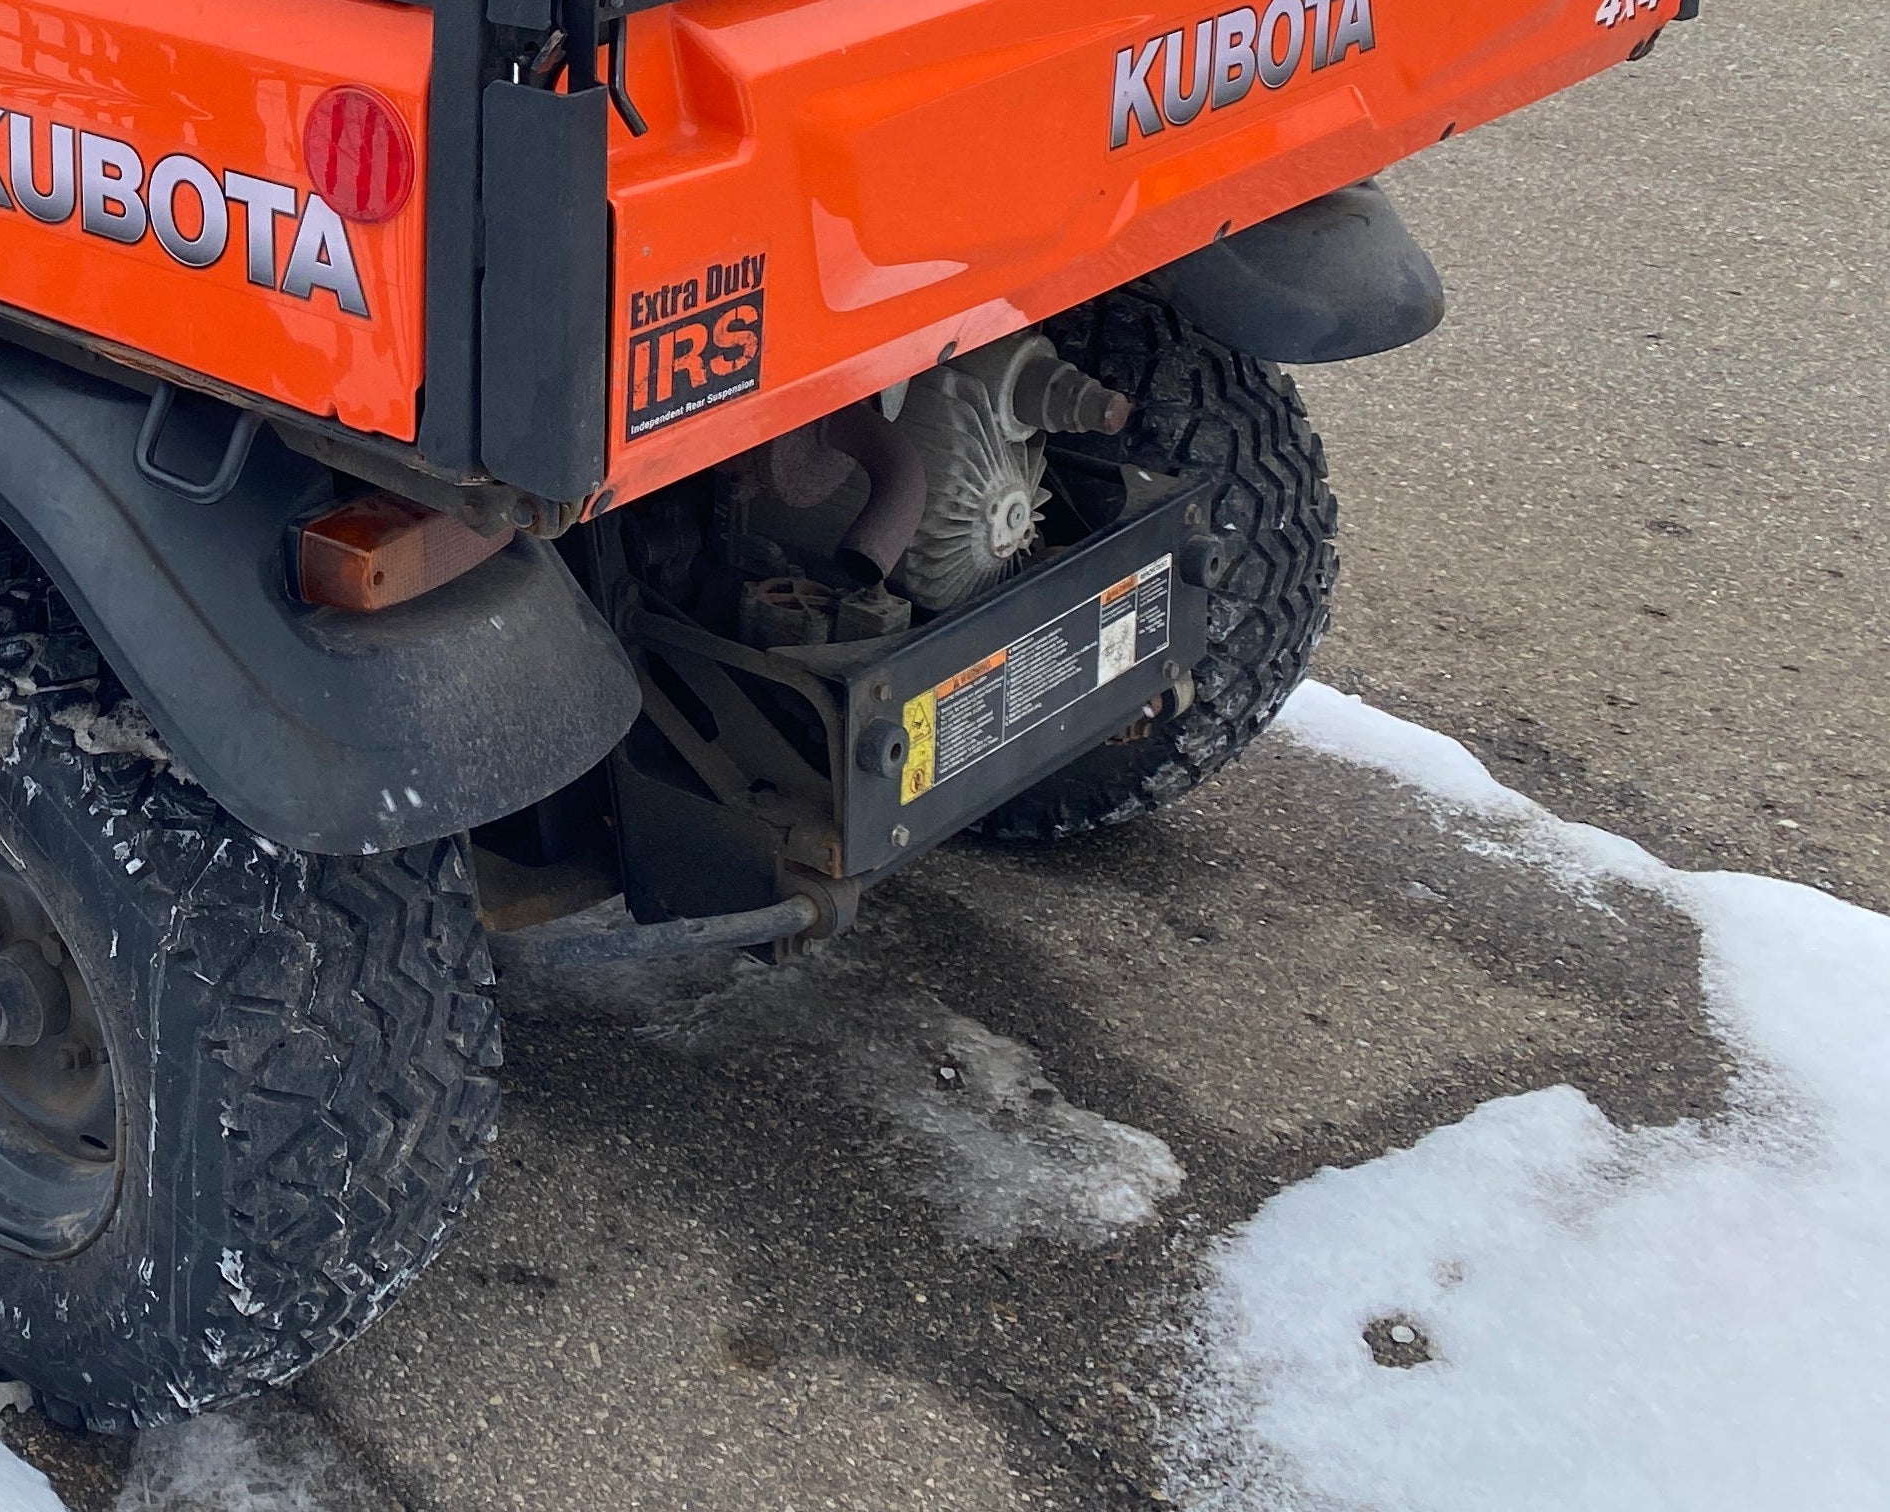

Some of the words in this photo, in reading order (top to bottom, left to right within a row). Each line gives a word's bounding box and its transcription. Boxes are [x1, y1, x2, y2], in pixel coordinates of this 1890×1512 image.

[631, 279, 698, 329] Extra
[706, 252, 765, 303] Duty
[633, 304, 759, 412] IRS
[631, 406, 684, 434] Independent
[686, 398, 706, 412] Rear
[707, 378, 755, 404] Suspension
